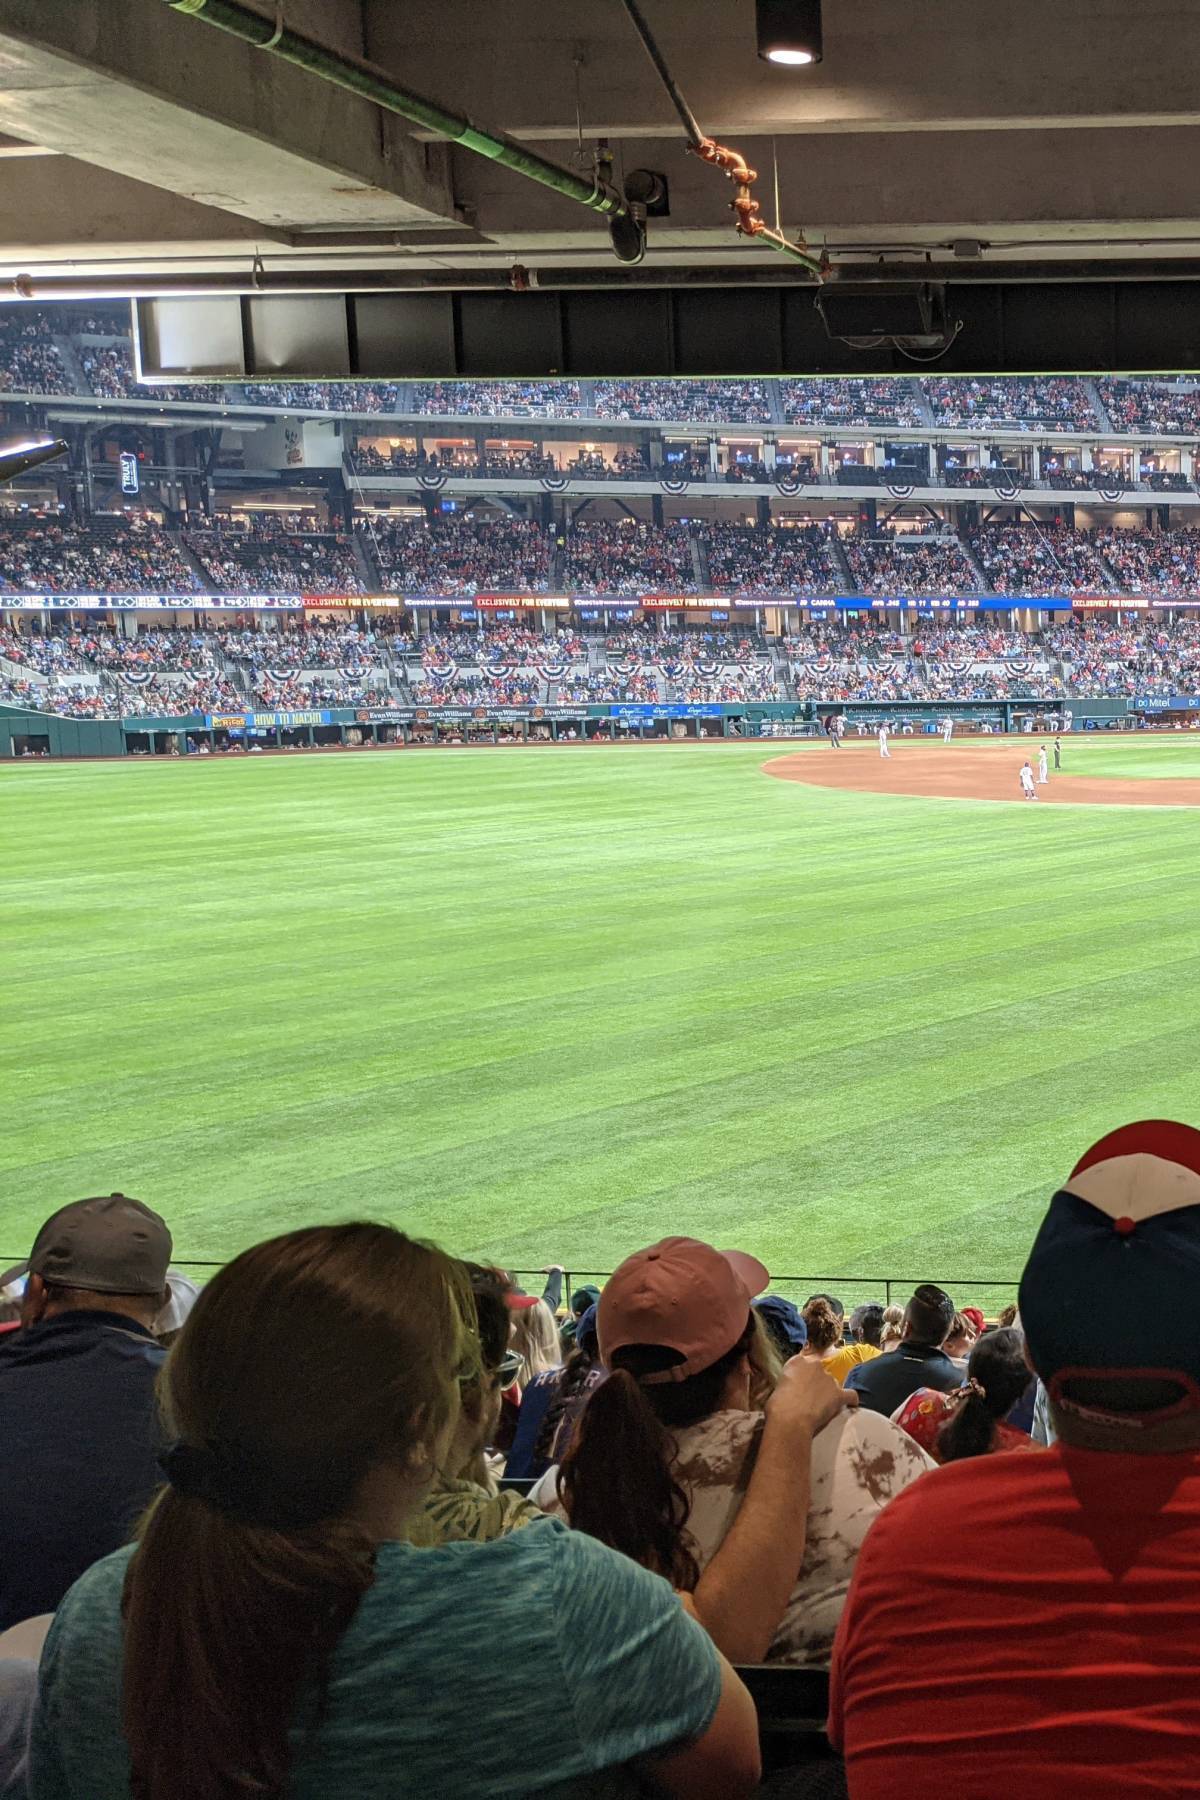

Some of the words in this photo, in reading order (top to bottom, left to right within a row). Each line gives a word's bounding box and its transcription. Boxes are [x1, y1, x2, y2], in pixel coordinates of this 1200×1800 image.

[122, 460, 131, 486] TRULY
[302, 598, 346, 606] EXCLUSIVELY
[477, 598, 520, 606] EXCLUSIVELY
[643, 598, 684, 606] EXCLUSIVELY
[1149, 699, 1170, 707] Mitel
[254, 713, 275, 726] HOW
[279, 713, 289, 725] TO
[292, 712, 321, 724] NACHO
